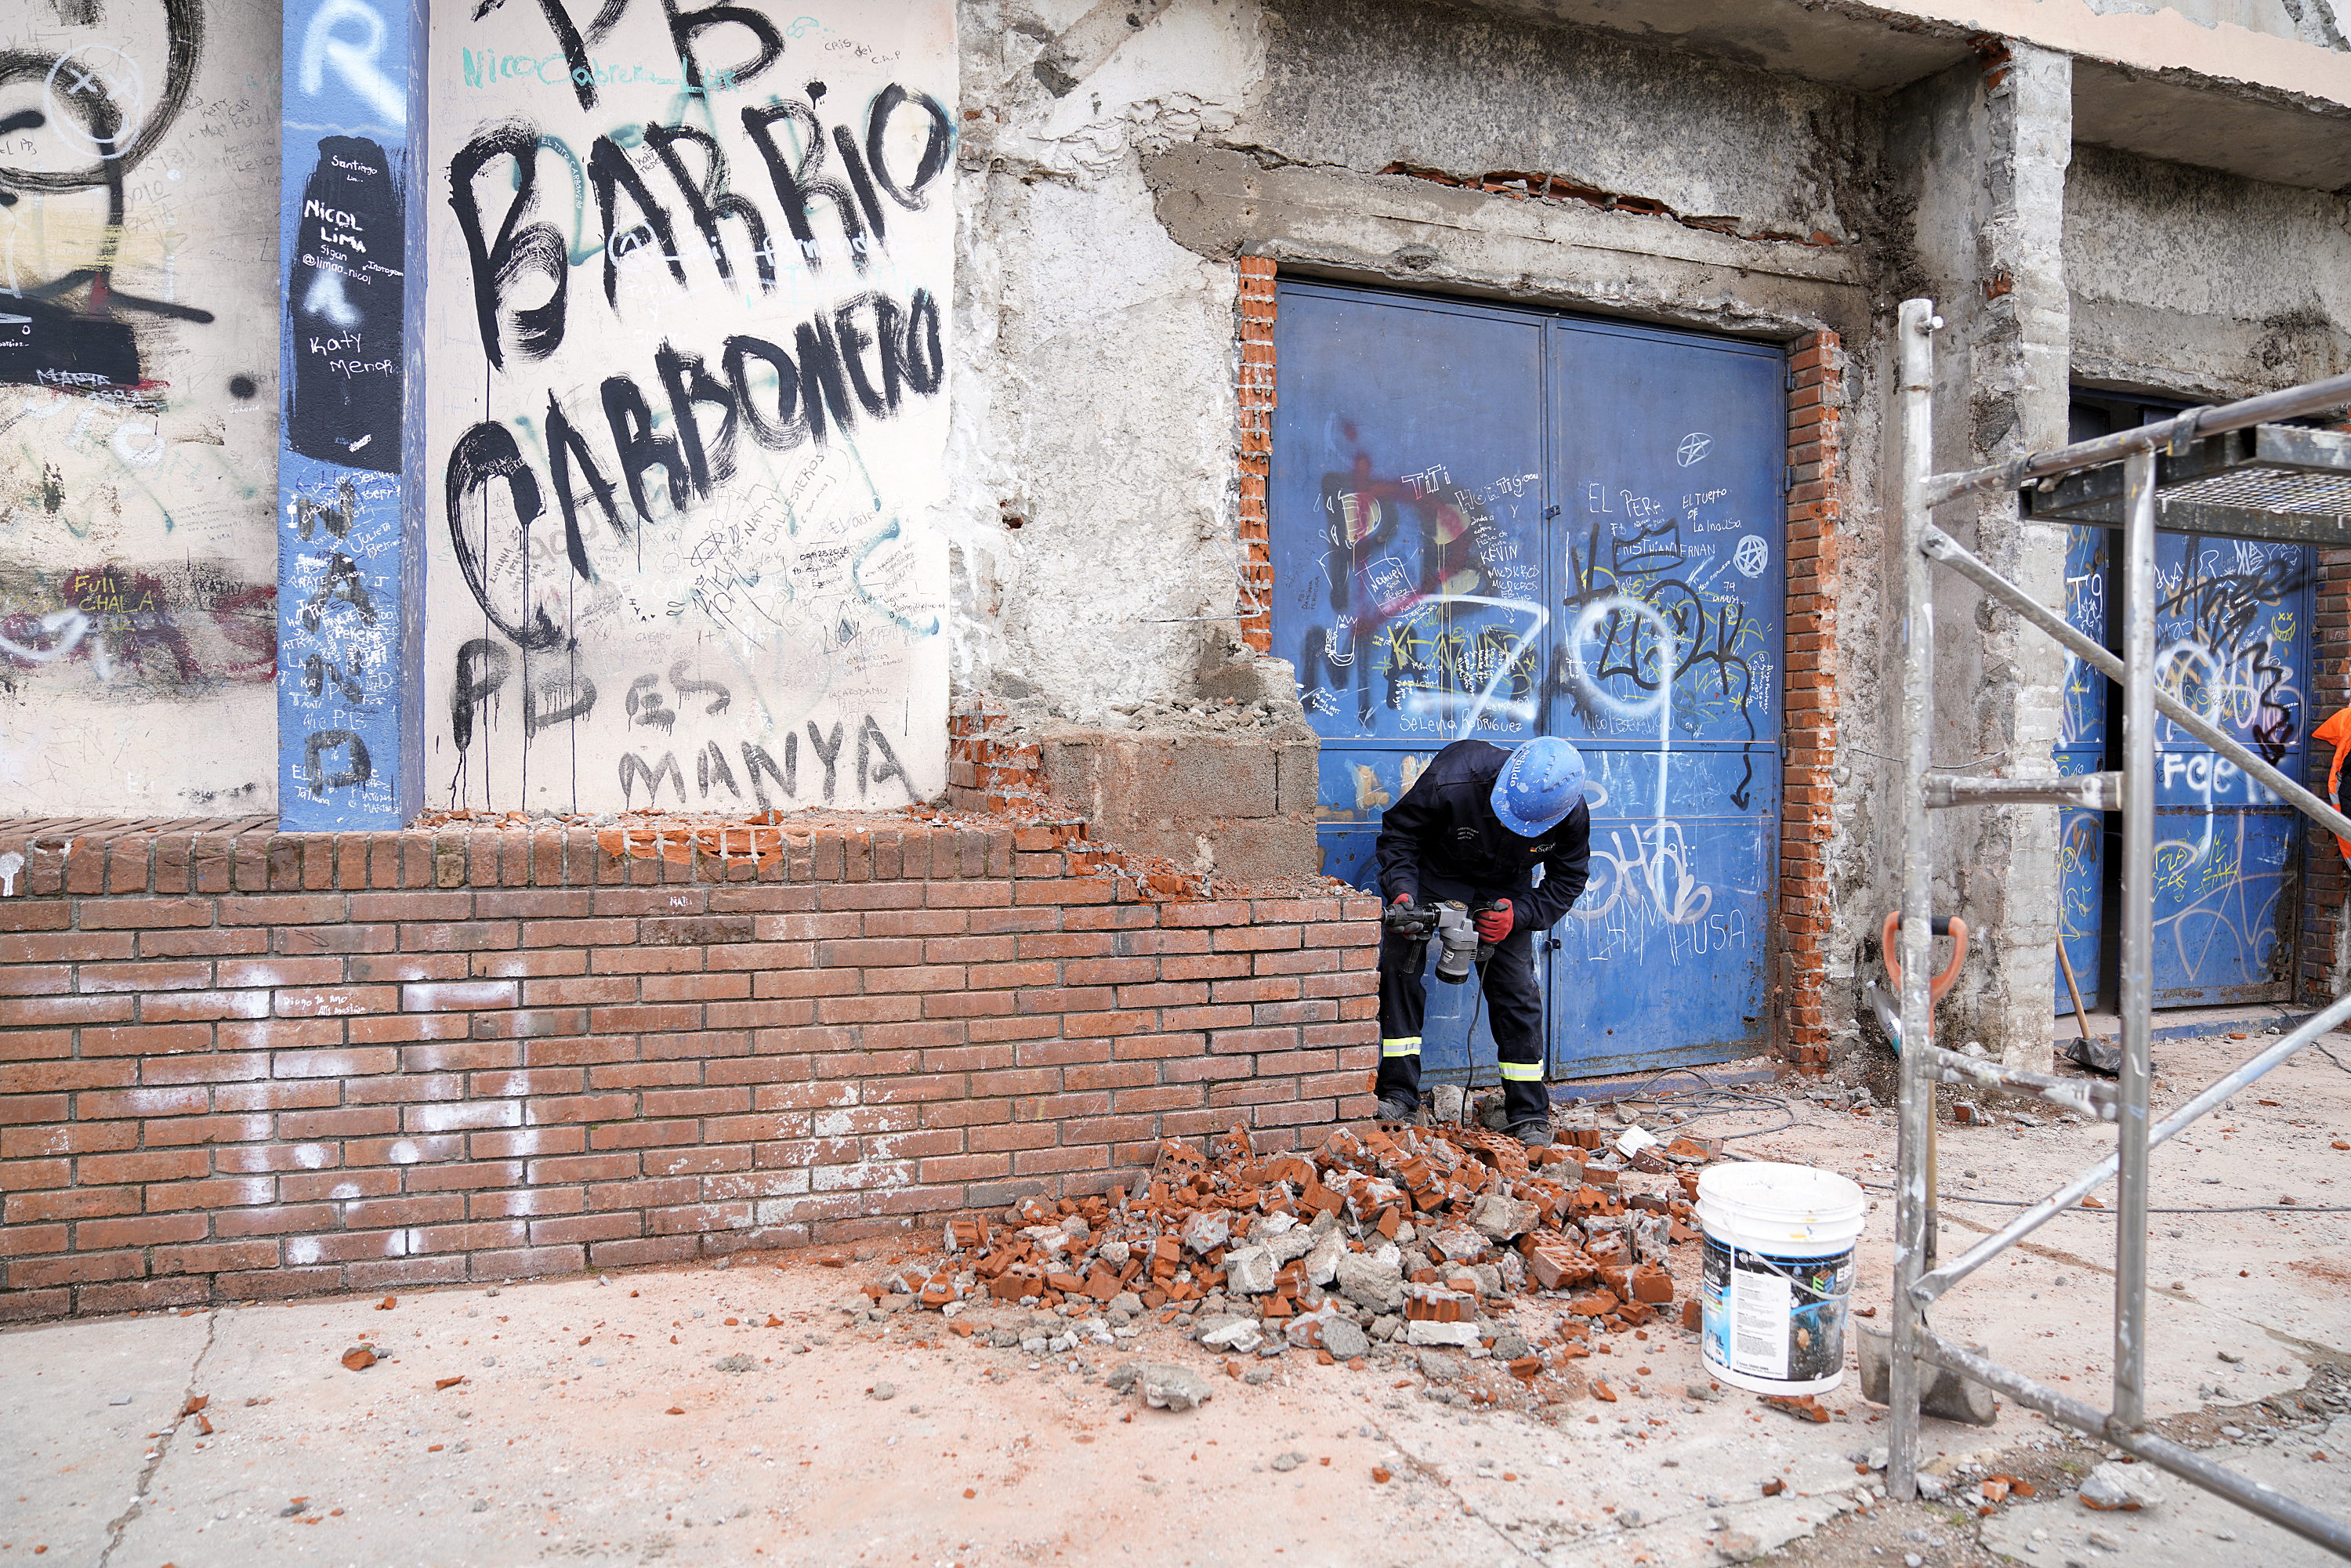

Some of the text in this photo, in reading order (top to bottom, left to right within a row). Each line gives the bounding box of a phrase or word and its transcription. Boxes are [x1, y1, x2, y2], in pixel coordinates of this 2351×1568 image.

[541, 136, 582, 208] EL TITO CARBONERO
[447, 81, 950, 372] BARRIO
[446, 287, 945, 649] CARBONERO
[1589, 483, 1613, 513] EL
[1480, 545, 1517, 564] KEVIN
[74, 574, 117, 594] Full
[79, 589, 156, 612] CHALA
[620, 714, 922, 809] MANYA
